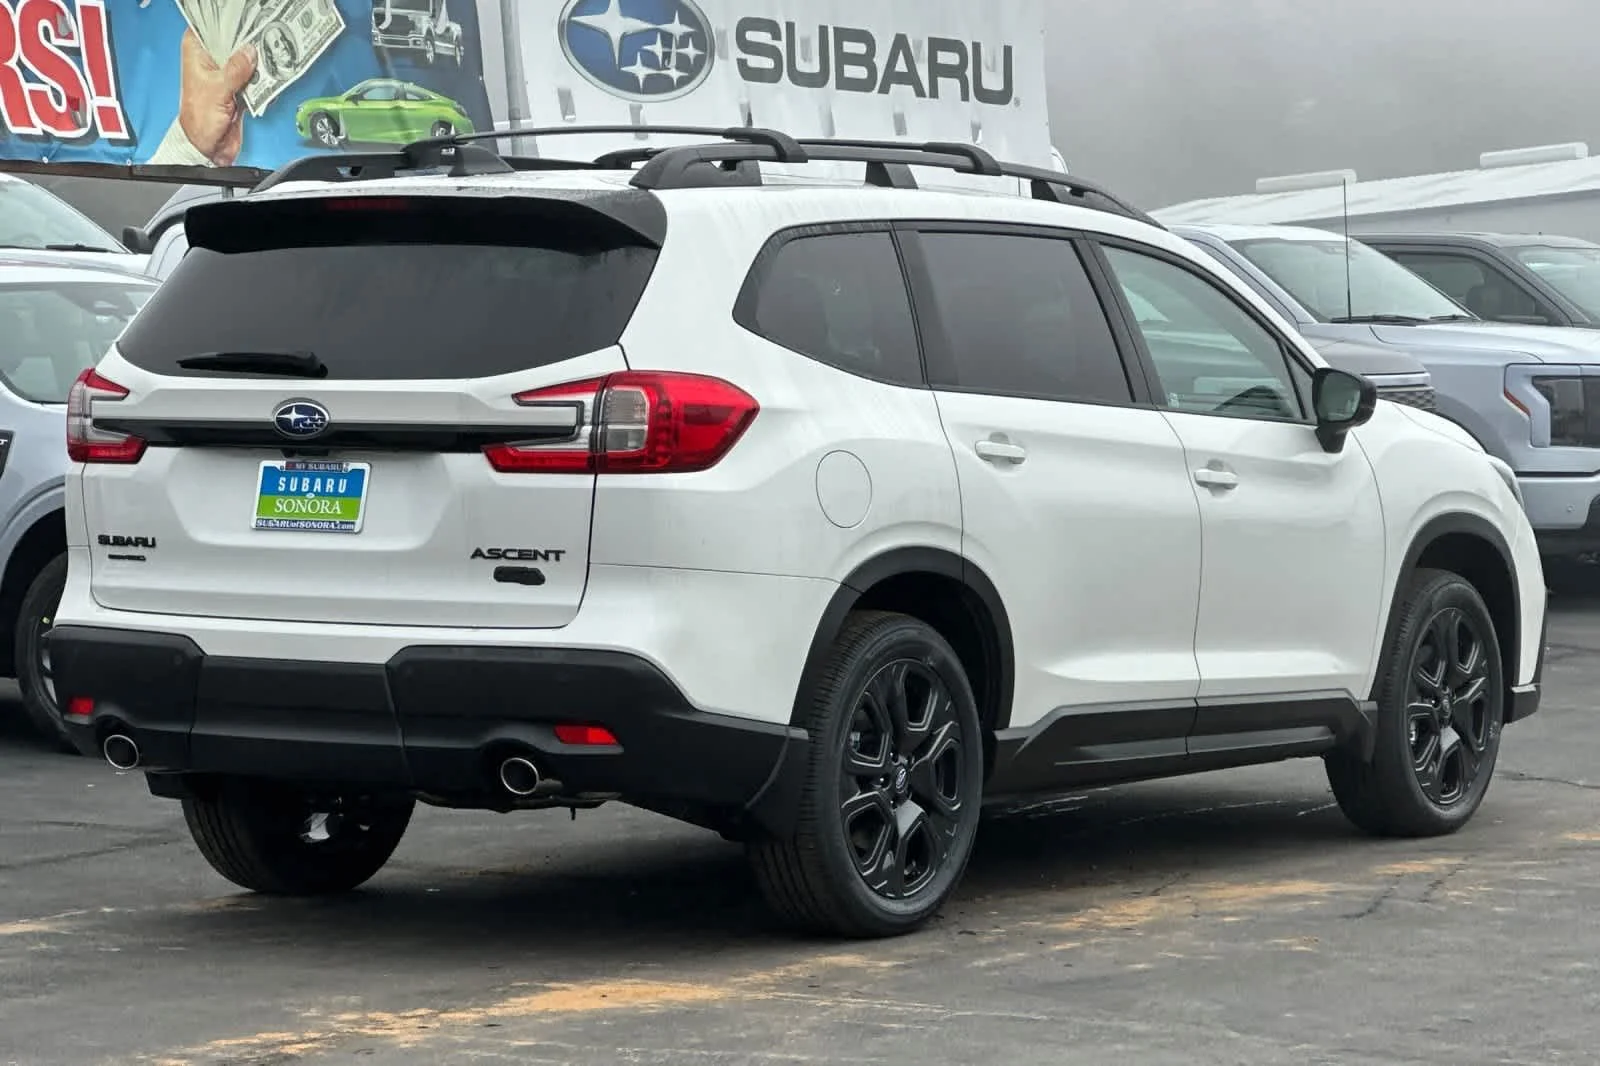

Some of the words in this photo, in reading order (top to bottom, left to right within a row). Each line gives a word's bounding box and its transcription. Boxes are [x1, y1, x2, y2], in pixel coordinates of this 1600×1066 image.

[735, 16, 1013, 106] SUBARU
[307, 462, 343, 471] SUBARU
[278, 476, 348, 493] SUBARU
[274, 498, 342, 515] SONORA
[97, 534, 157, 549] SUBARU
[470, 547, 566, 562] ASCENT
